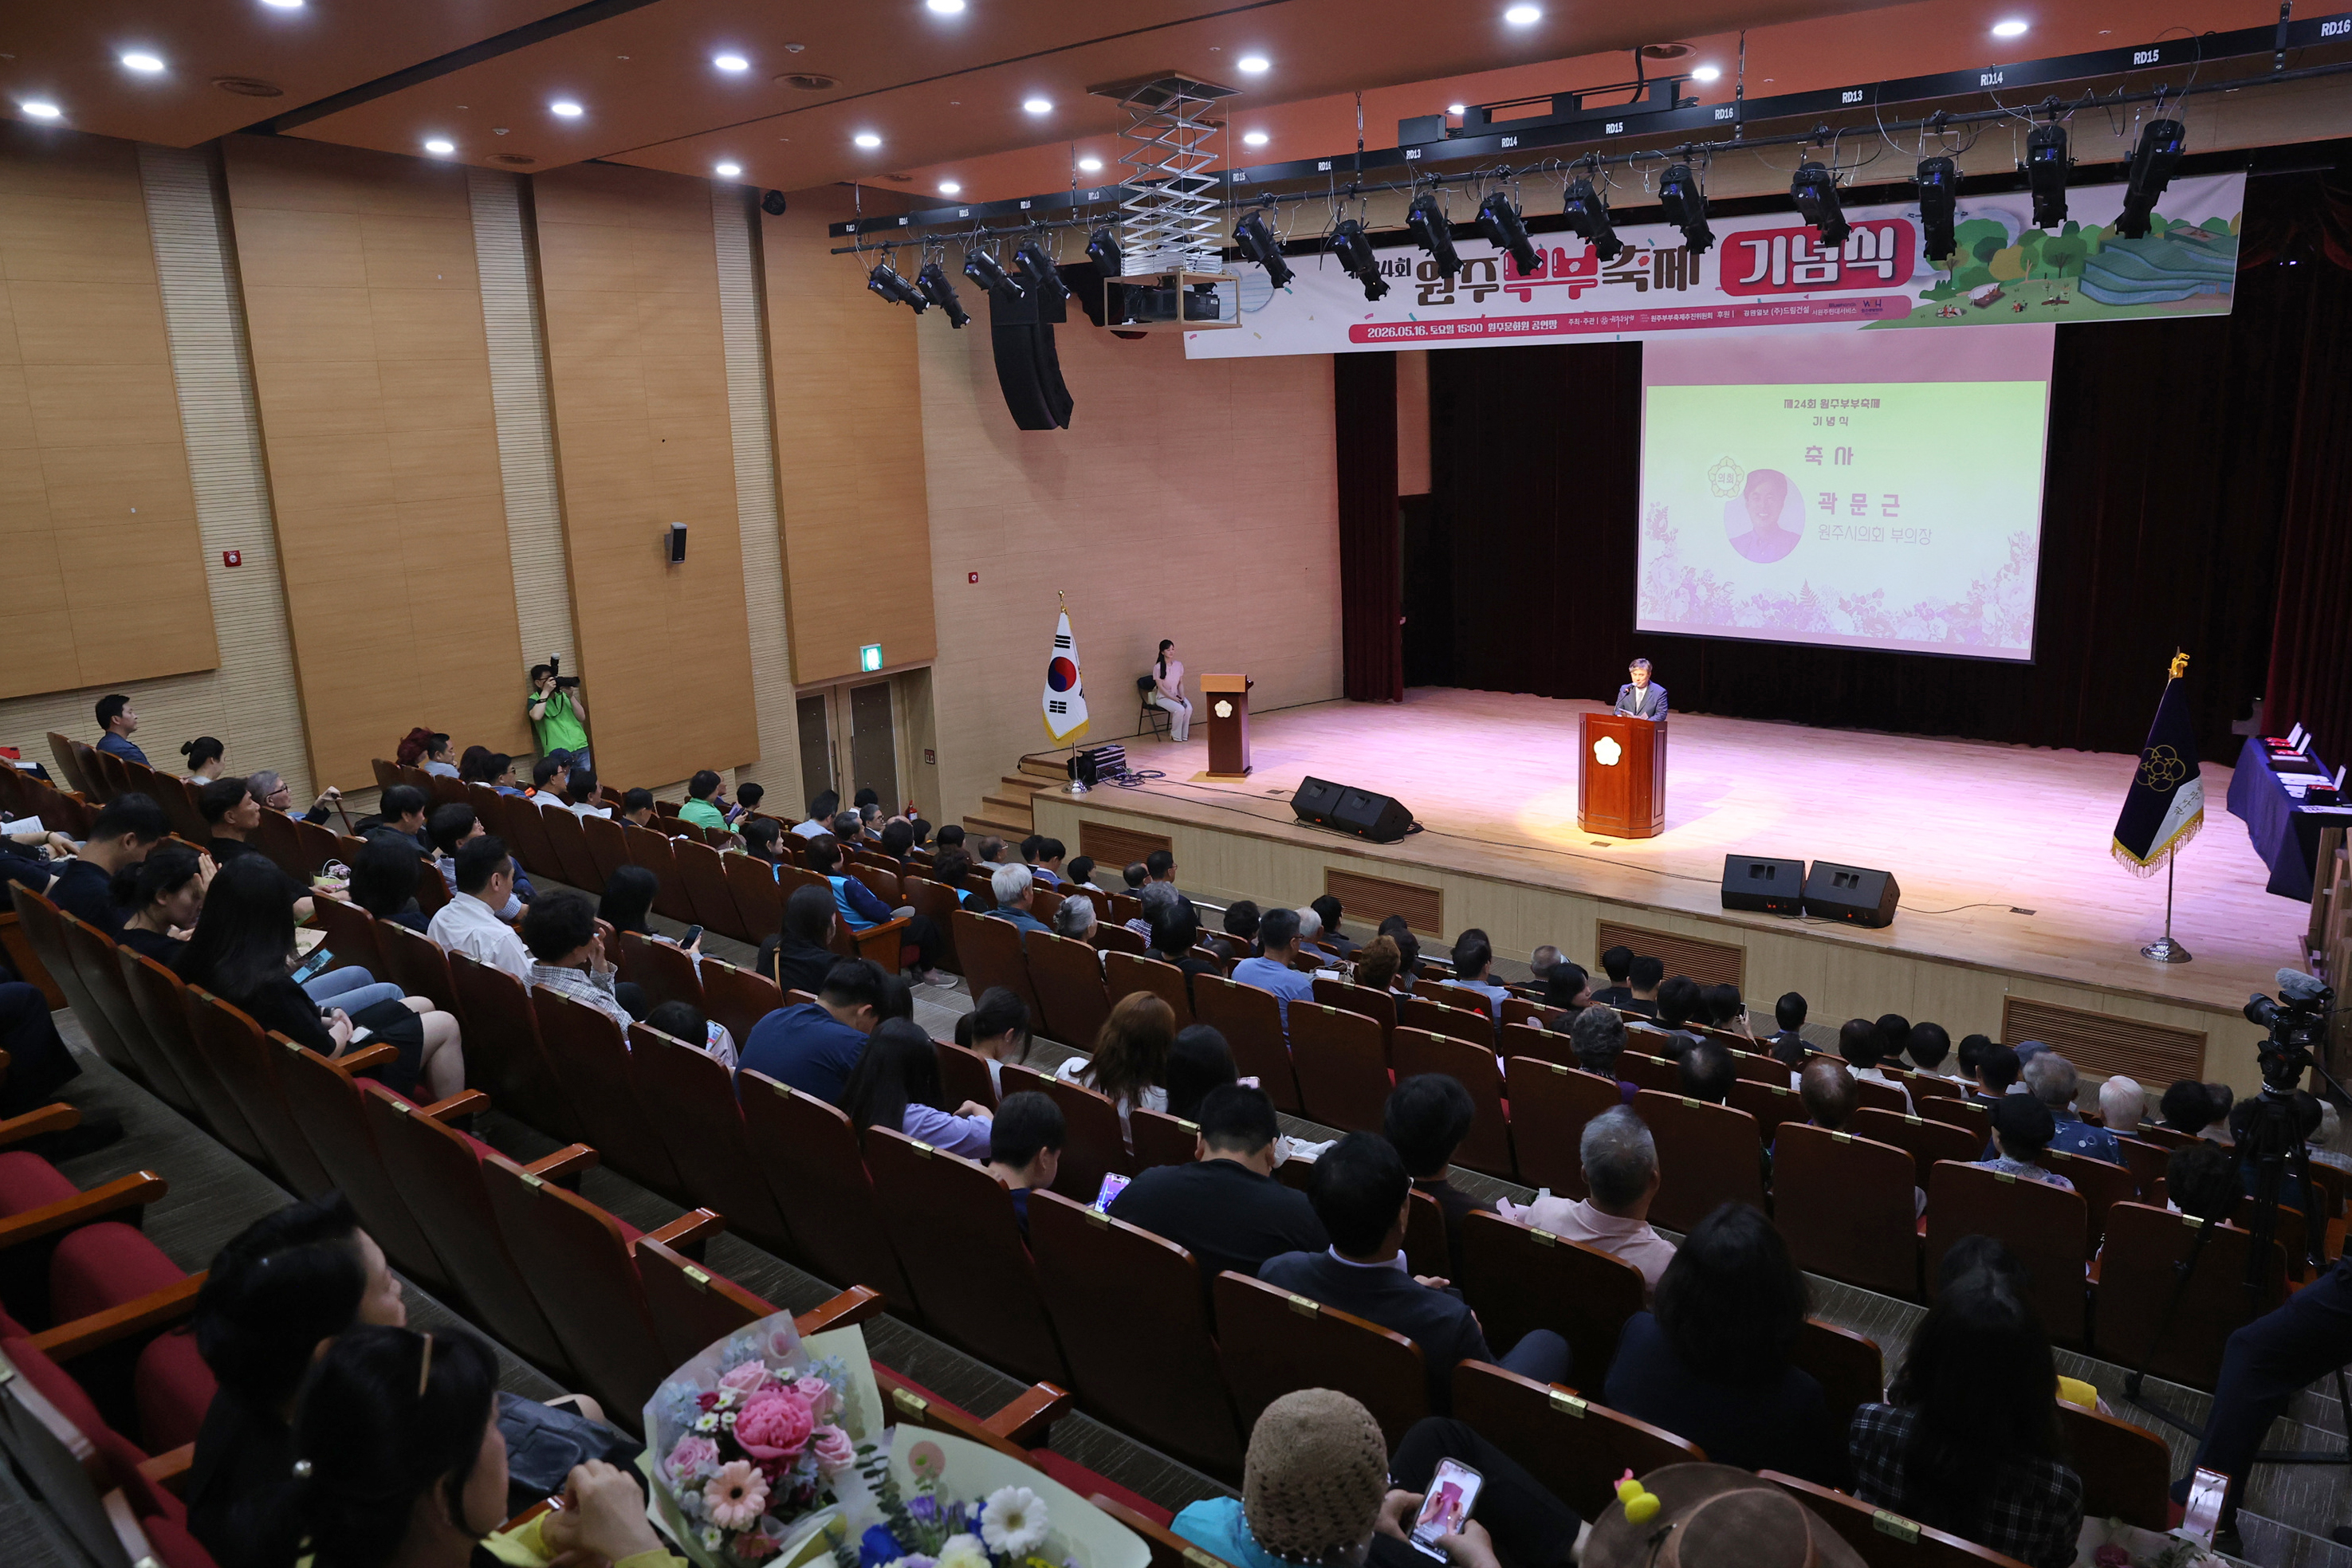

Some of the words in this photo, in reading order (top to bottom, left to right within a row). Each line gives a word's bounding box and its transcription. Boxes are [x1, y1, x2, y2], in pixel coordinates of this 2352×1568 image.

[2321, 19, 2351, 37] RD16
[2134, 49, 2159, 65] RD15
[1980, 72, 2004, 87] RD14
[1842, 90, 1863, 104] RD13
[1715, 107, 1734, 120] RD16
[1606, 121, 1623, 135] RD15
[1501, 136, 1518, 148] RD14
[1406, 148, 1422, 160] RD13
[1318, 161, 1331, 172] RD16
[1232, 172, 1246, 183] RD15
[1739, 226, 1895, 285] 기념식
[1367, 325, 1429, 338] 2026.05.16.
[1430, 324, 1455, 335] 토요일
[1457, 323, 1483, 333] 15:00
[1488, 320, 1530, 332] 원주문화원
[1784, 399, 1816, 409] 제24회
[1820, 398, 1880, 410] 원주부부축제
[1818, 524, 1884, 543] 원주시의회
[1890, 528, 1933, 546] 부의장
